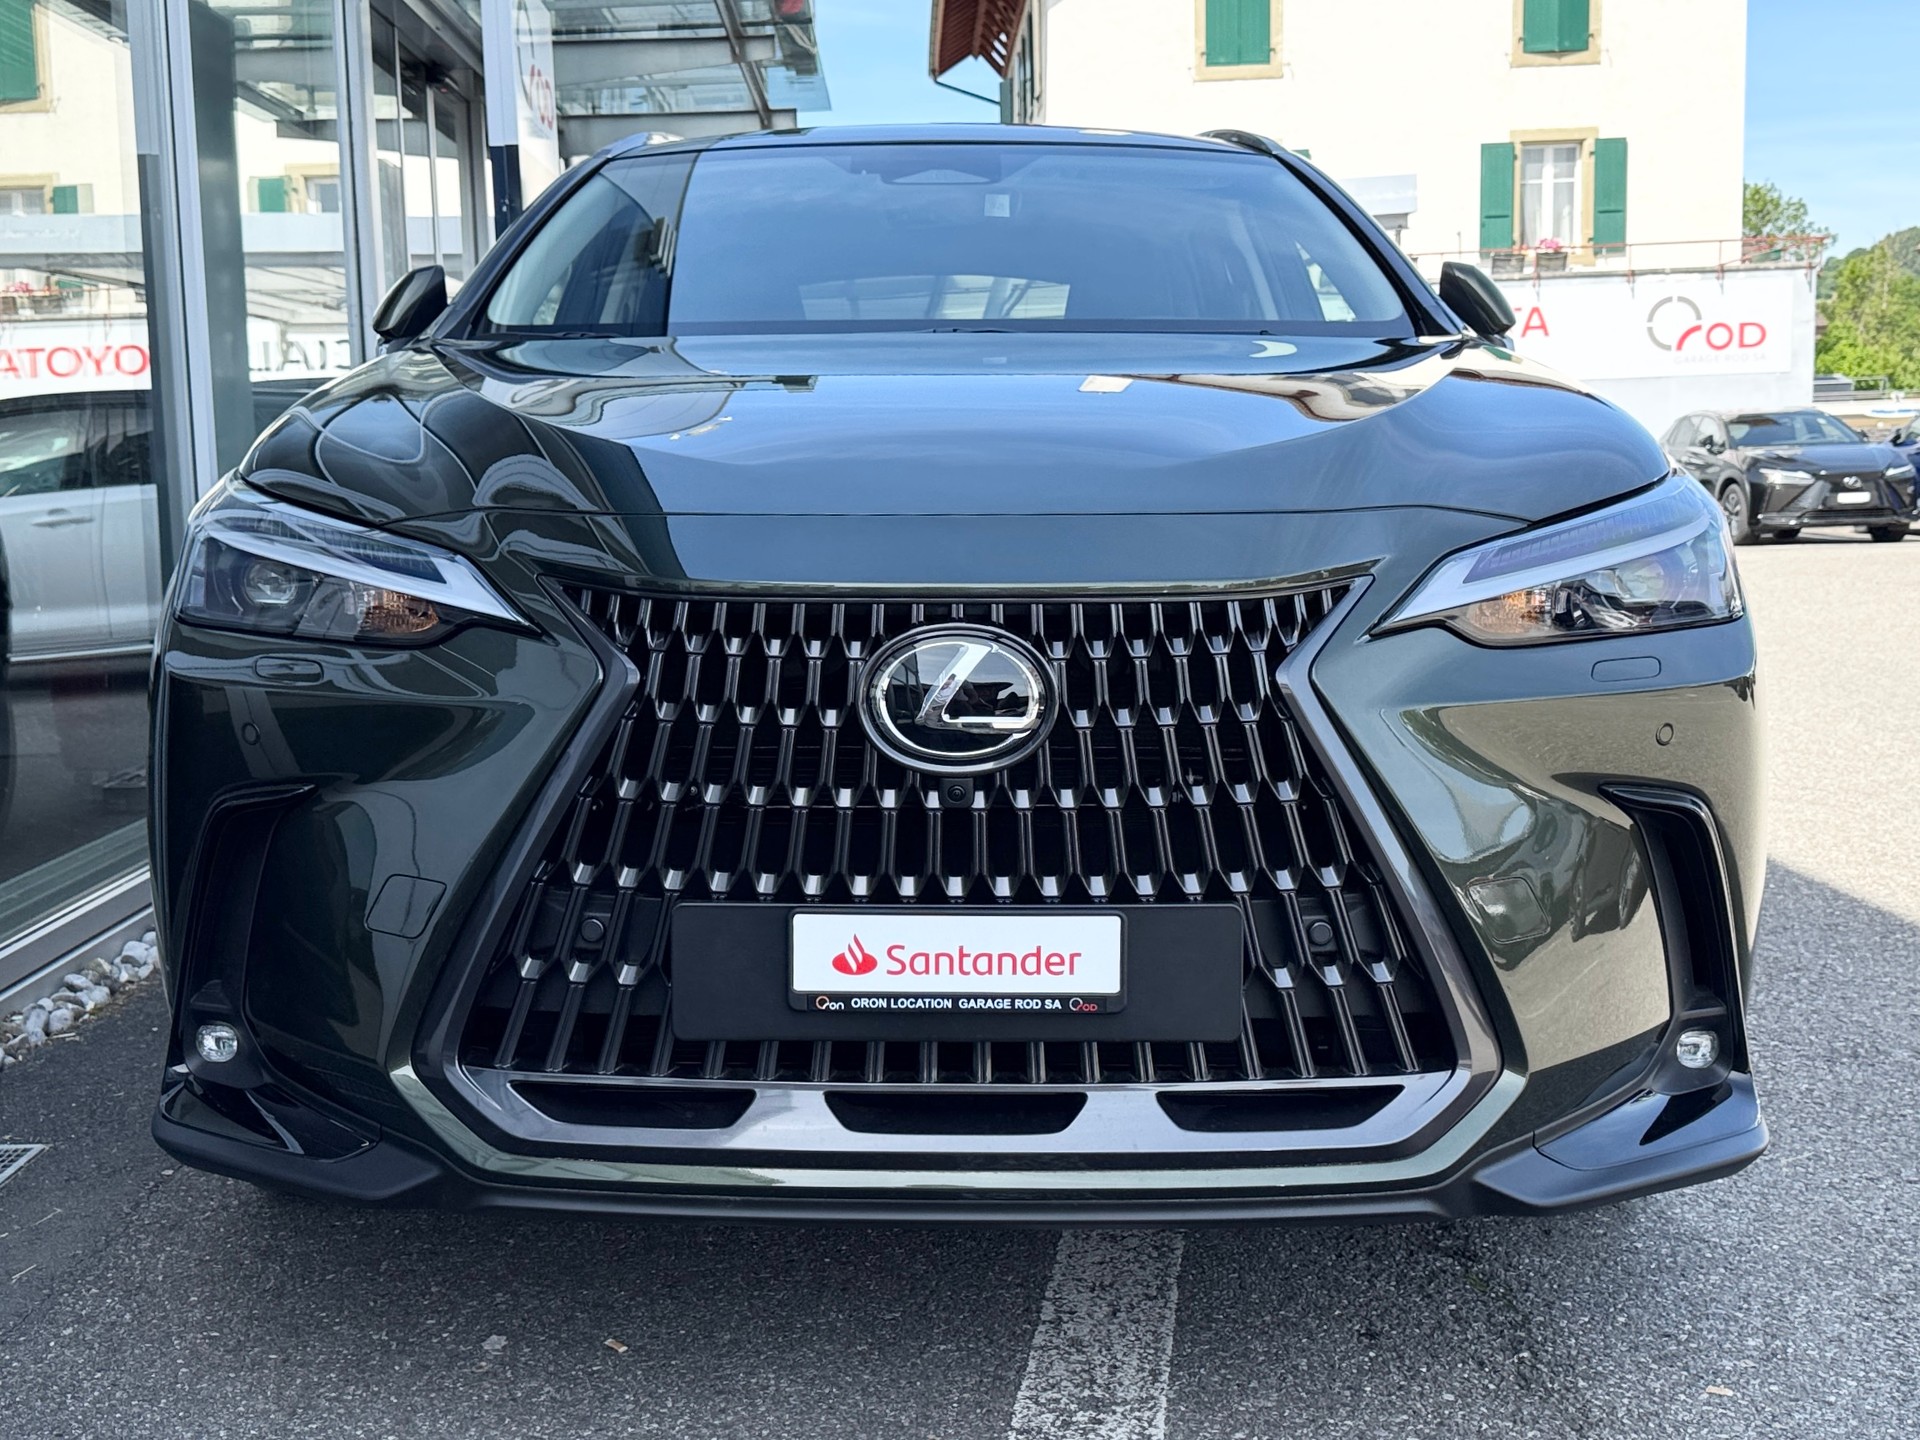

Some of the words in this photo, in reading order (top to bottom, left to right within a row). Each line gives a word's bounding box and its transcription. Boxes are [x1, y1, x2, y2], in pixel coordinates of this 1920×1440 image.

[886, 944, 1082, 976] Santander
[851, 998, 887, 1009] ORON
[890, 998, 952, 1009] LOCATION
[958, 998, 1012, 1010] GARAGE
[1014, 998, 1042, 1010] ROD
[1044, 998, 1062, 1010] SA
